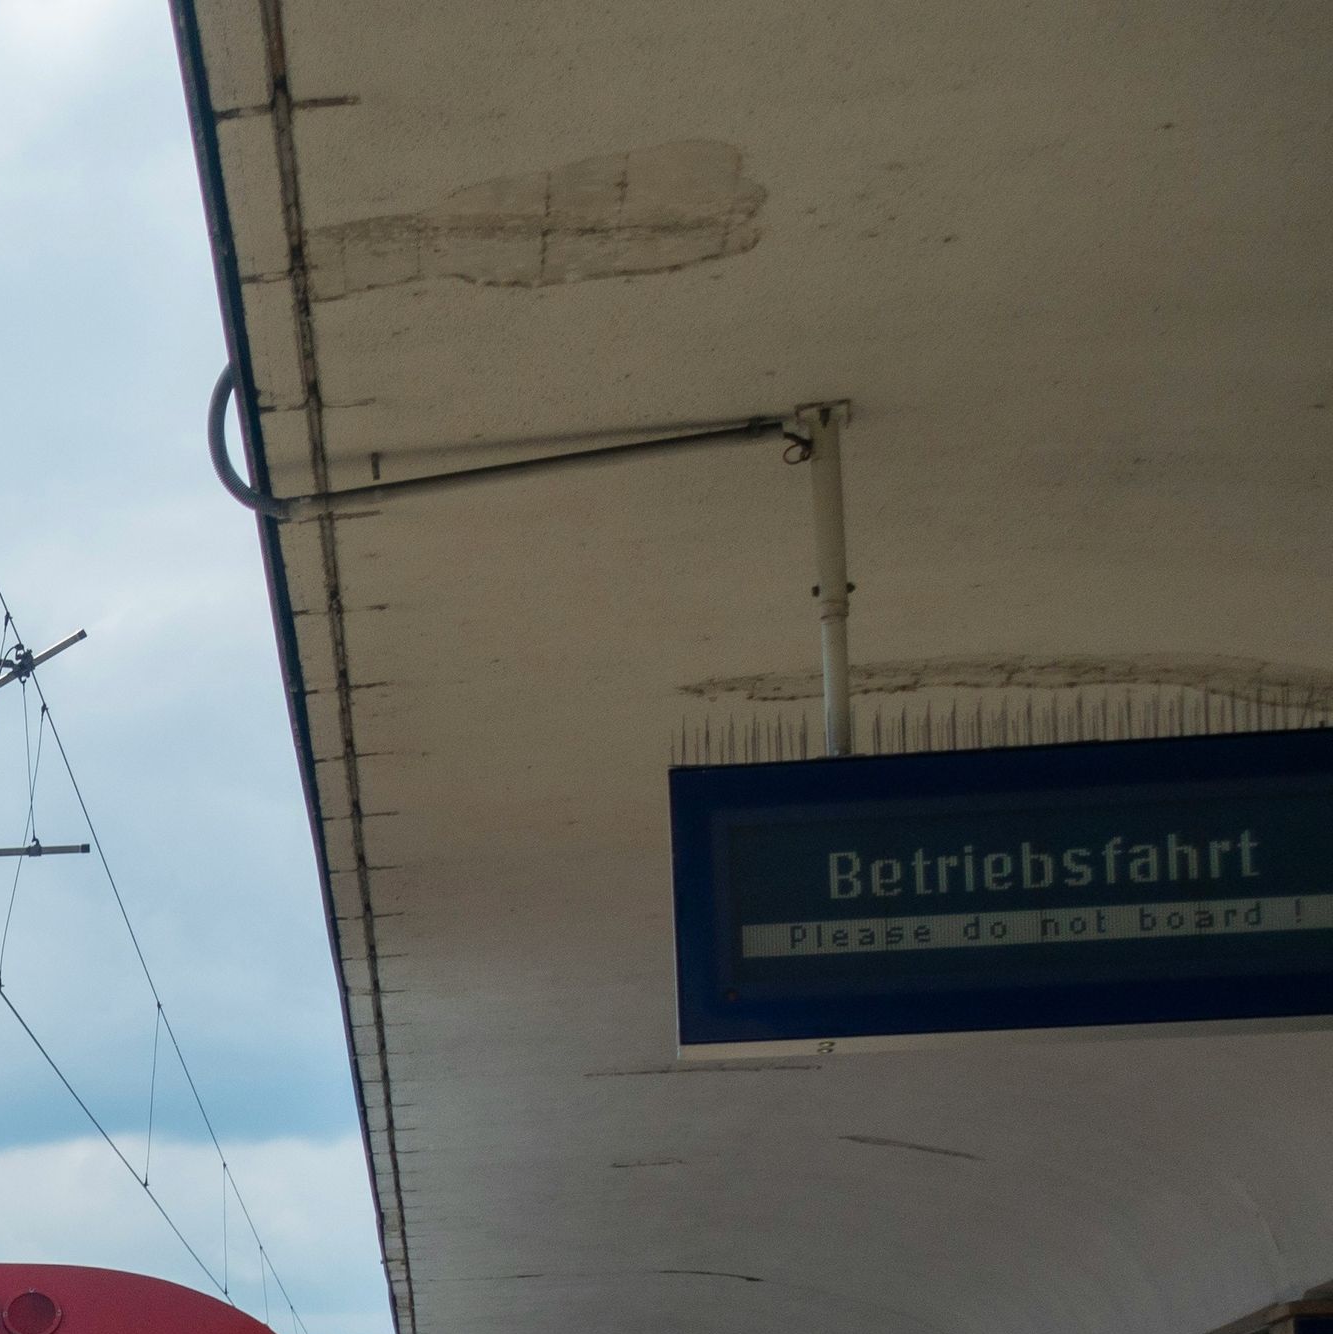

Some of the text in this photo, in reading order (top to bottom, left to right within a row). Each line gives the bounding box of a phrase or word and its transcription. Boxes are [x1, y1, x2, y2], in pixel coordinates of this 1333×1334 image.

[828, 829, 1260, 899] Betriebsfahrt
[790, 923, 931, 949] Please
[963, 916, 1007, 941] do
[1040, 909, 1106, 936] not
[1139, 902, 1262, 932] board
